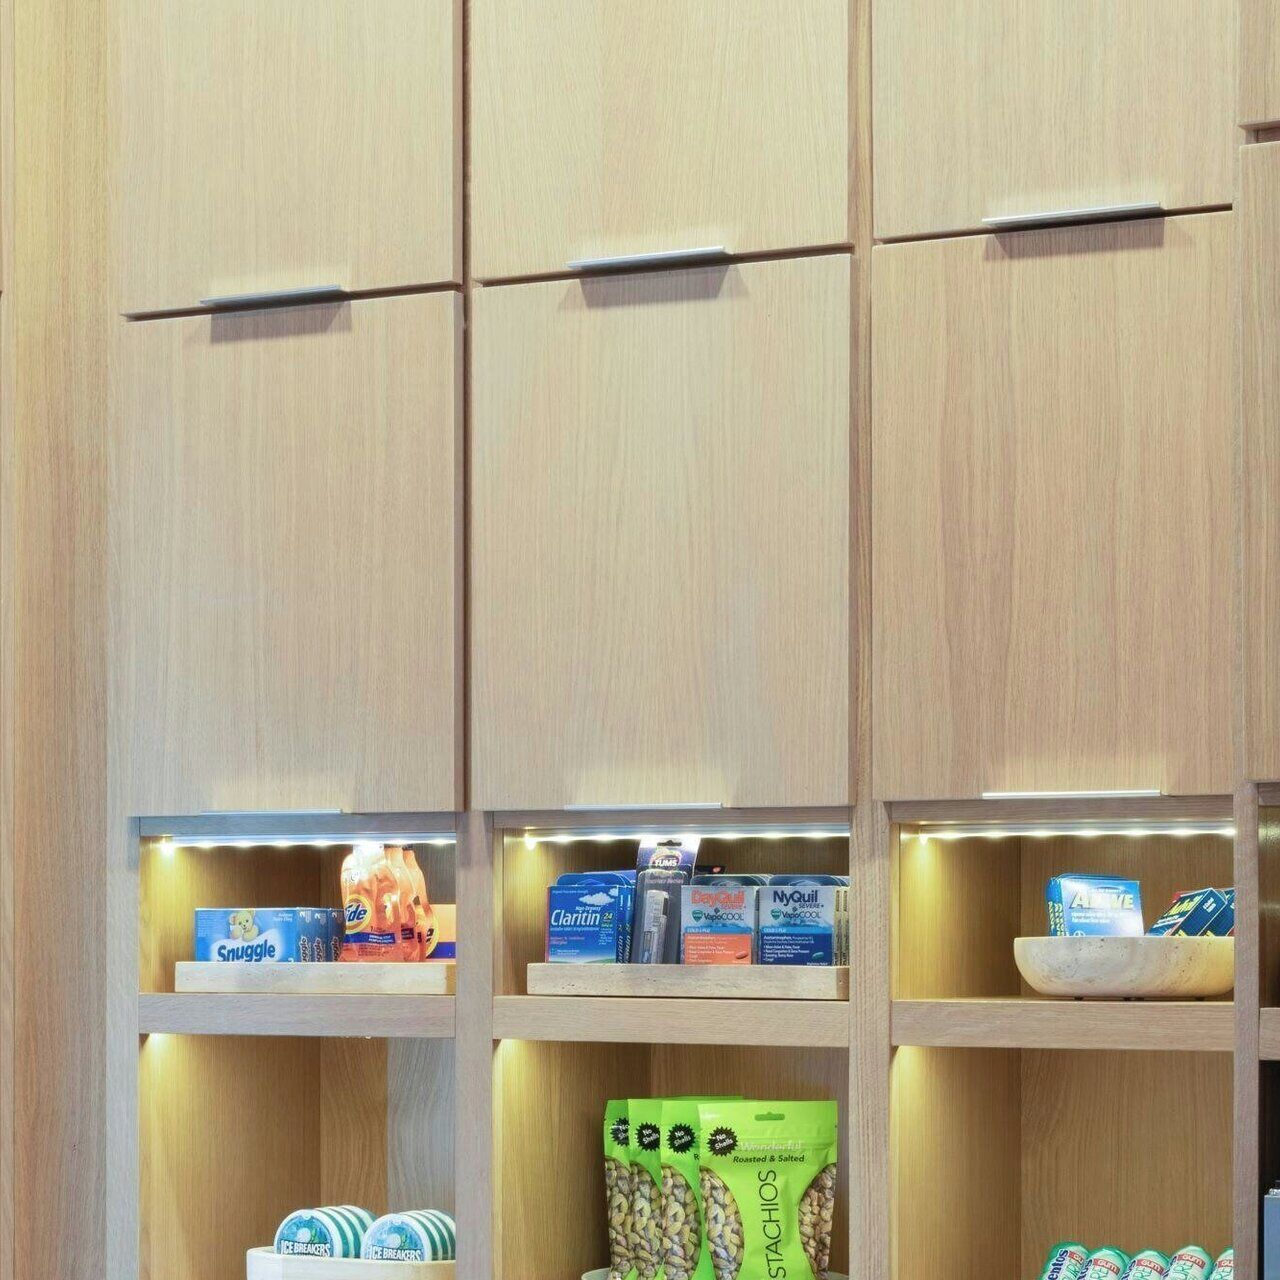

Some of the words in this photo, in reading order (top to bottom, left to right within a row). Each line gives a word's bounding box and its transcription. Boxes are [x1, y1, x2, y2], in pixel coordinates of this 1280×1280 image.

[654, 859, 677, 867] TUMS
[691, 888, 745, 908] DayQuil
[773, 890, 818, 906] NyQuil
[1069, 891, 1134, 910] AVE
[551, 909, 600, 926] Claritin
[603, 912, 613, 920] 24
[217, 939, 276, 962] Snuggle
[642, 1132, 660, 1145] Shells
[673, 1135, 692, 1147] Shells
[716, 1133, 726, 1141] No
[714, 1138, 734, 1150] Shells
[739, 1140, 803, 1151] Wonderful
[733, 1154, 768, 1163] Roasted
[769, 1154, 775, 1162] &
[778, 1154, 805, 1163] Salted
[281, 1240, 296, 1255] ICE
[295, 1241, 331, 1257] BREAKERS
[370, 1245, 384, 1259] ICE
[383, 1246, 422, 1261] BREAKERS
